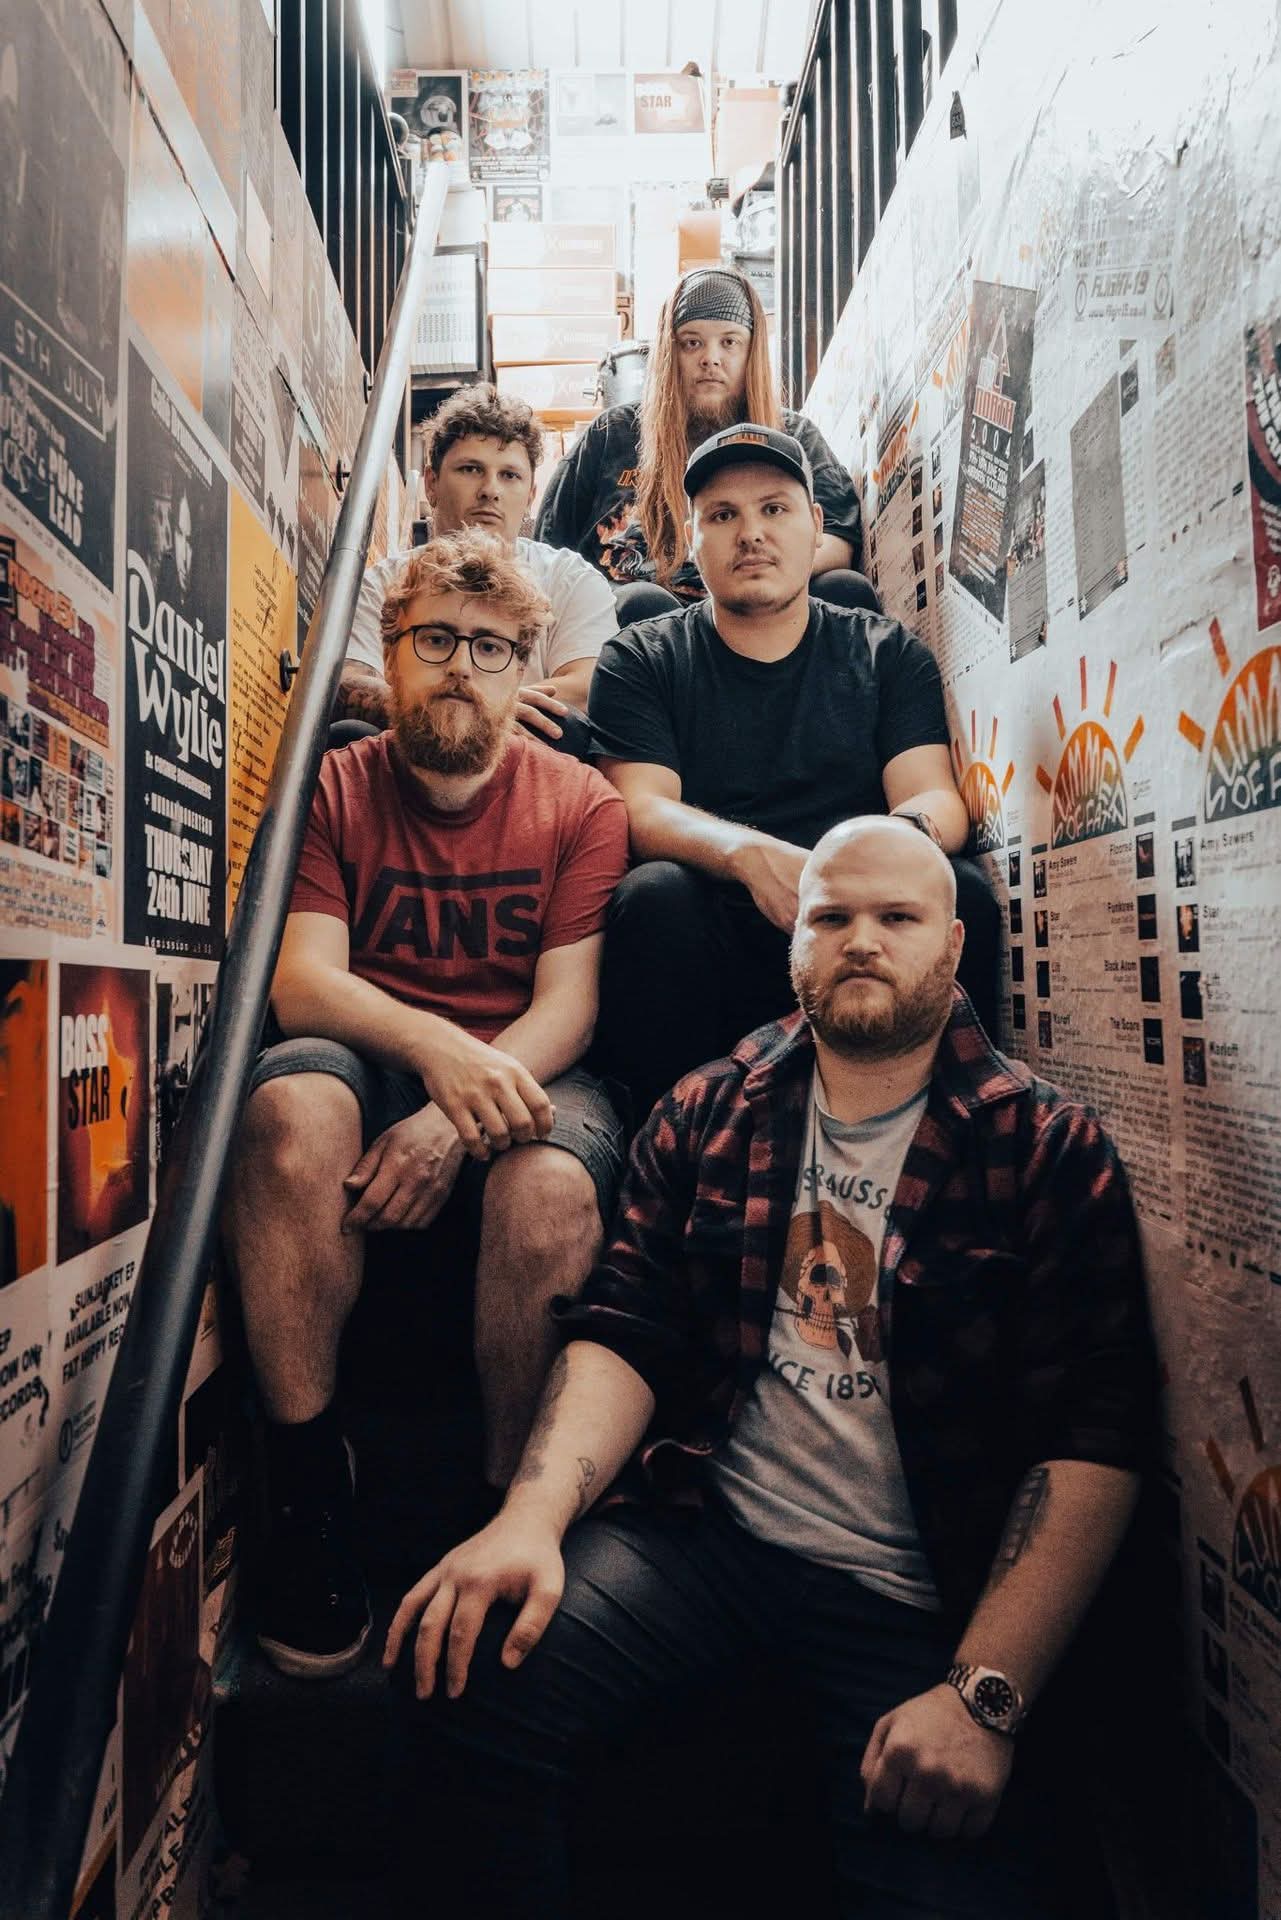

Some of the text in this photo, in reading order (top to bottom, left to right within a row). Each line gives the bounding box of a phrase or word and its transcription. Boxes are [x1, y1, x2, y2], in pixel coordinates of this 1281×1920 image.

[640, 95, 672, 108] STAR
[14, 319, 51, 376] 9TH
[63, 366, 103, 420] JULY
[48, 446, 84, 513] PURE
[49, 483, 83, 547] LEAD
[127, 549, 226, 705] Daniel
[131, 636, 224, 769] Wylie
[144, 823, 214, 887] THURSDAY
[147, 870, 181, 921] 24th
[181, 880, 211, 927] JUNE
[342, 862, 543, 959] VANS
[60, 1013, 111, 1079] BOSS
[67, 1066, 111, 1131] STAR
